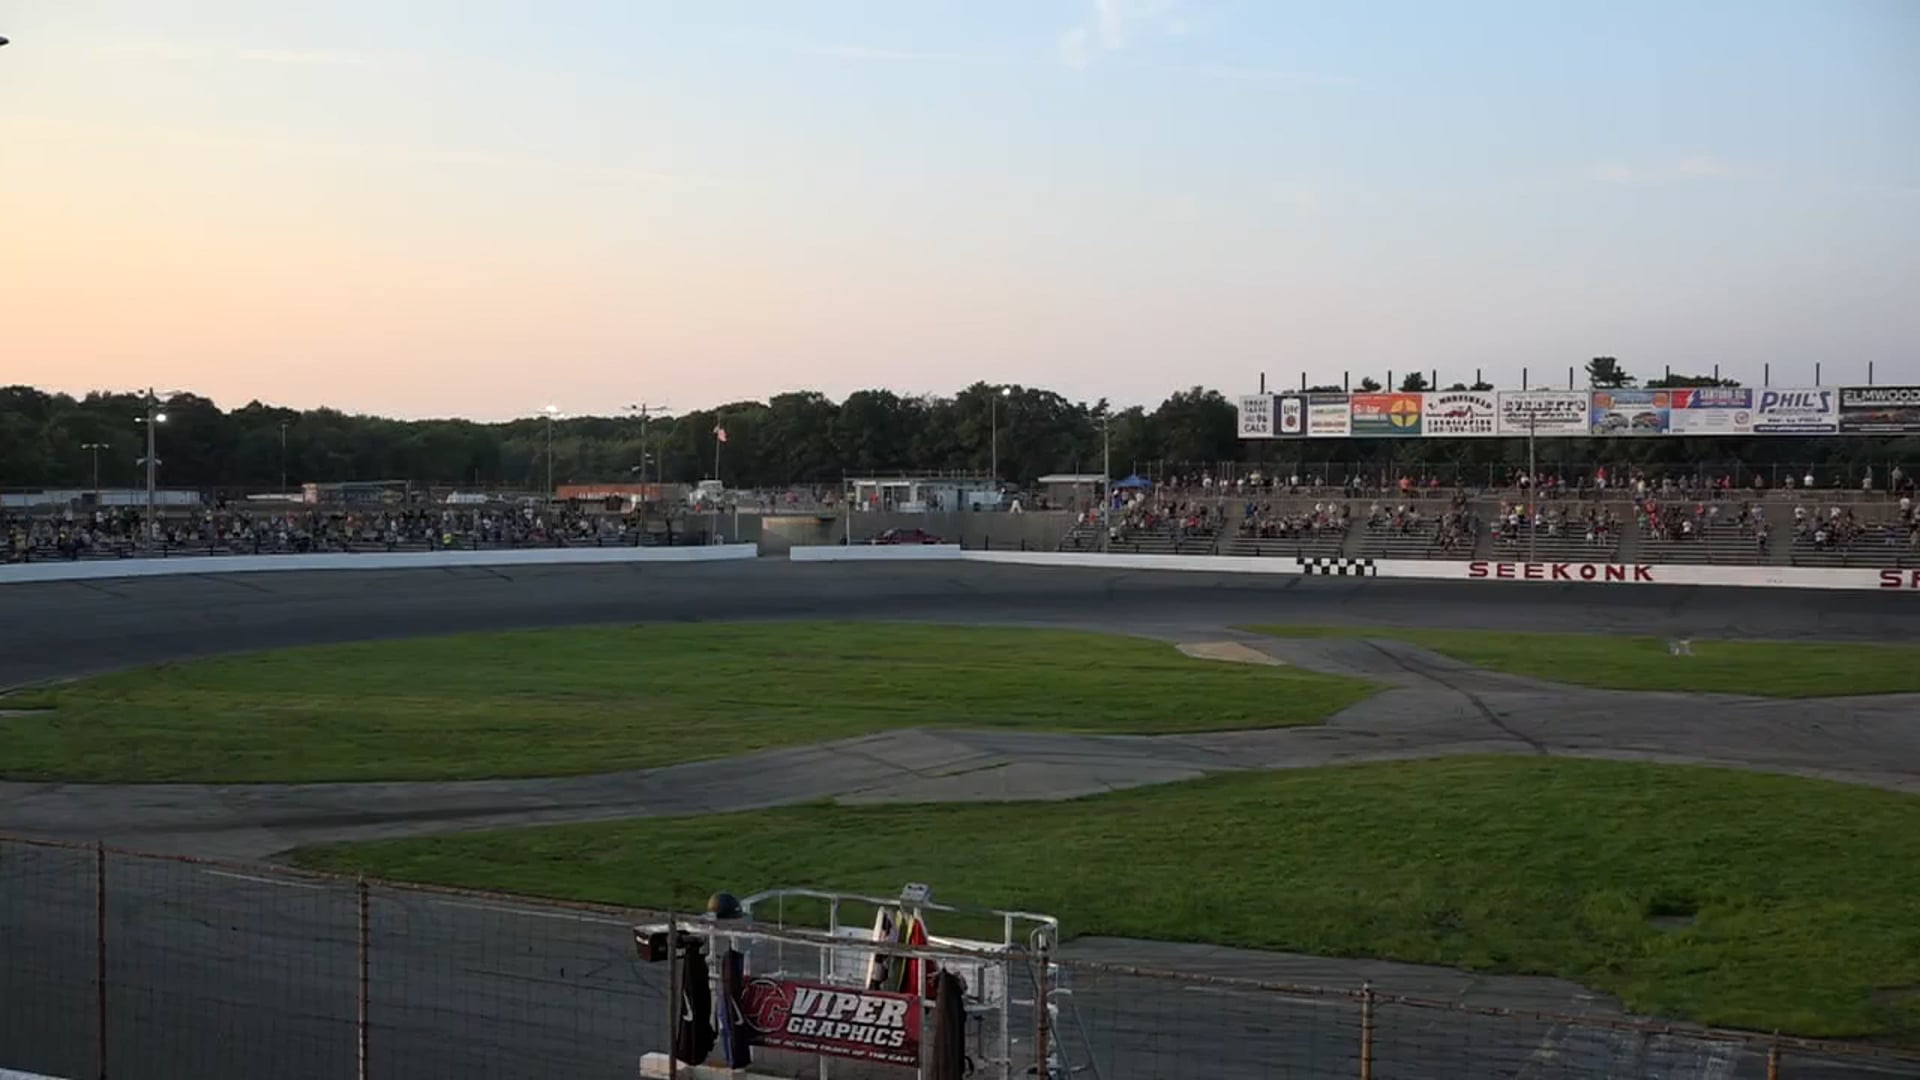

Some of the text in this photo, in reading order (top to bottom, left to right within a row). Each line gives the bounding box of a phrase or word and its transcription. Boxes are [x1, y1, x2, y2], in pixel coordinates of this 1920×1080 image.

[1759, 391, 1831, 413] PHIL'S
[1844, 390, 1920, 402] ELMWOOD
[1469, 562, 1653, 581] SEEKONK
[792, 987, 907, 1027] VIPER
[786, 1016, 906, 1047] GRAPHICS
